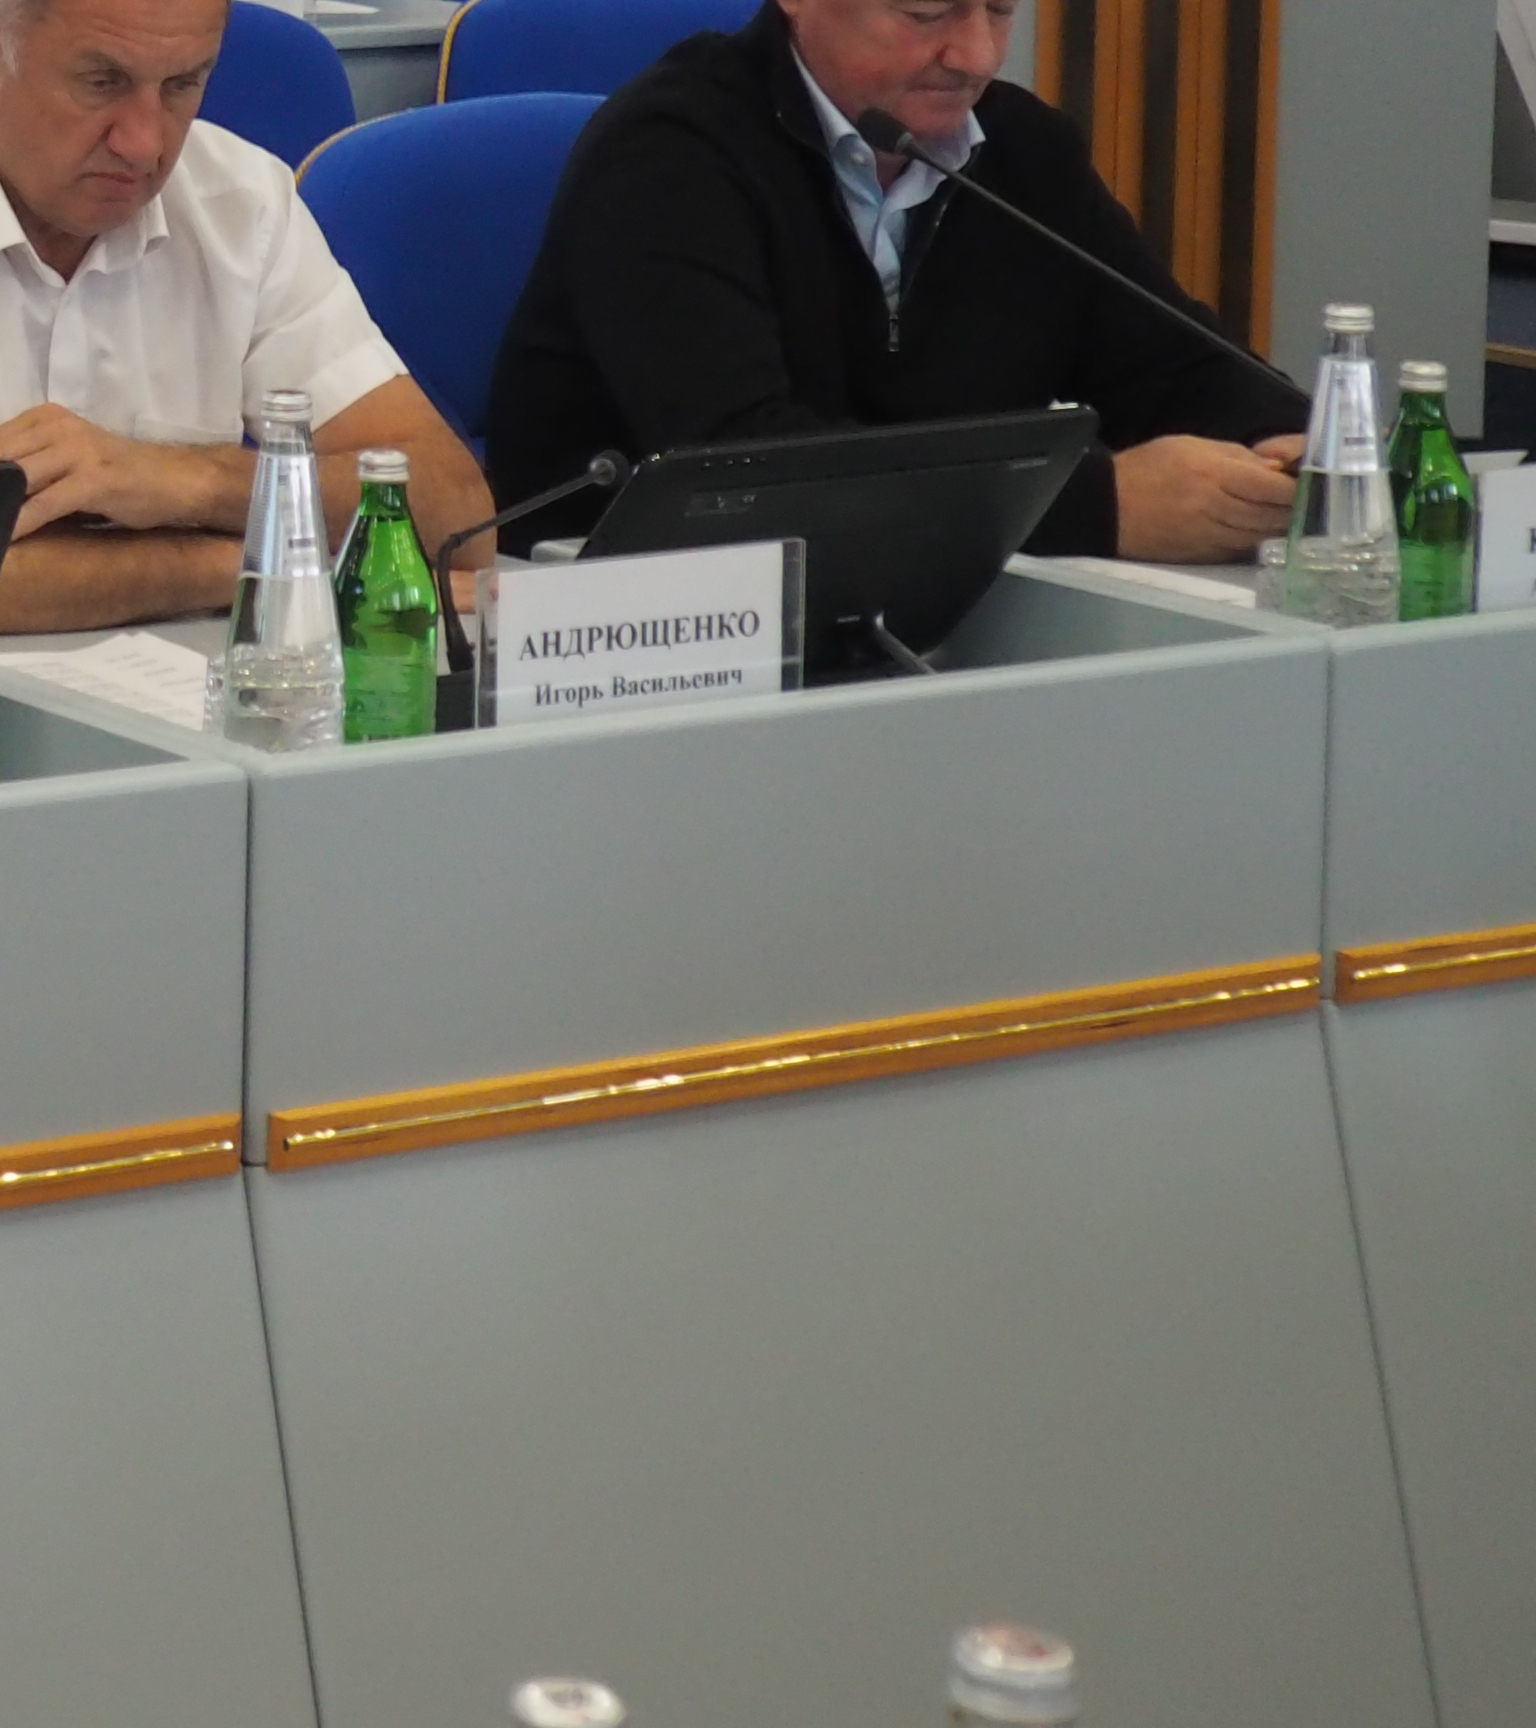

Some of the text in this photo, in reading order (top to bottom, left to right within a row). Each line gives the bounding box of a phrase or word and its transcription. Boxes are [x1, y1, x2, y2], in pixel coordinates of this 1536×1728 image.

[519, 610, 761, 661] АНДРЮЩЕНКО
[536, 668, 743, 708] Игорь Васильевич
